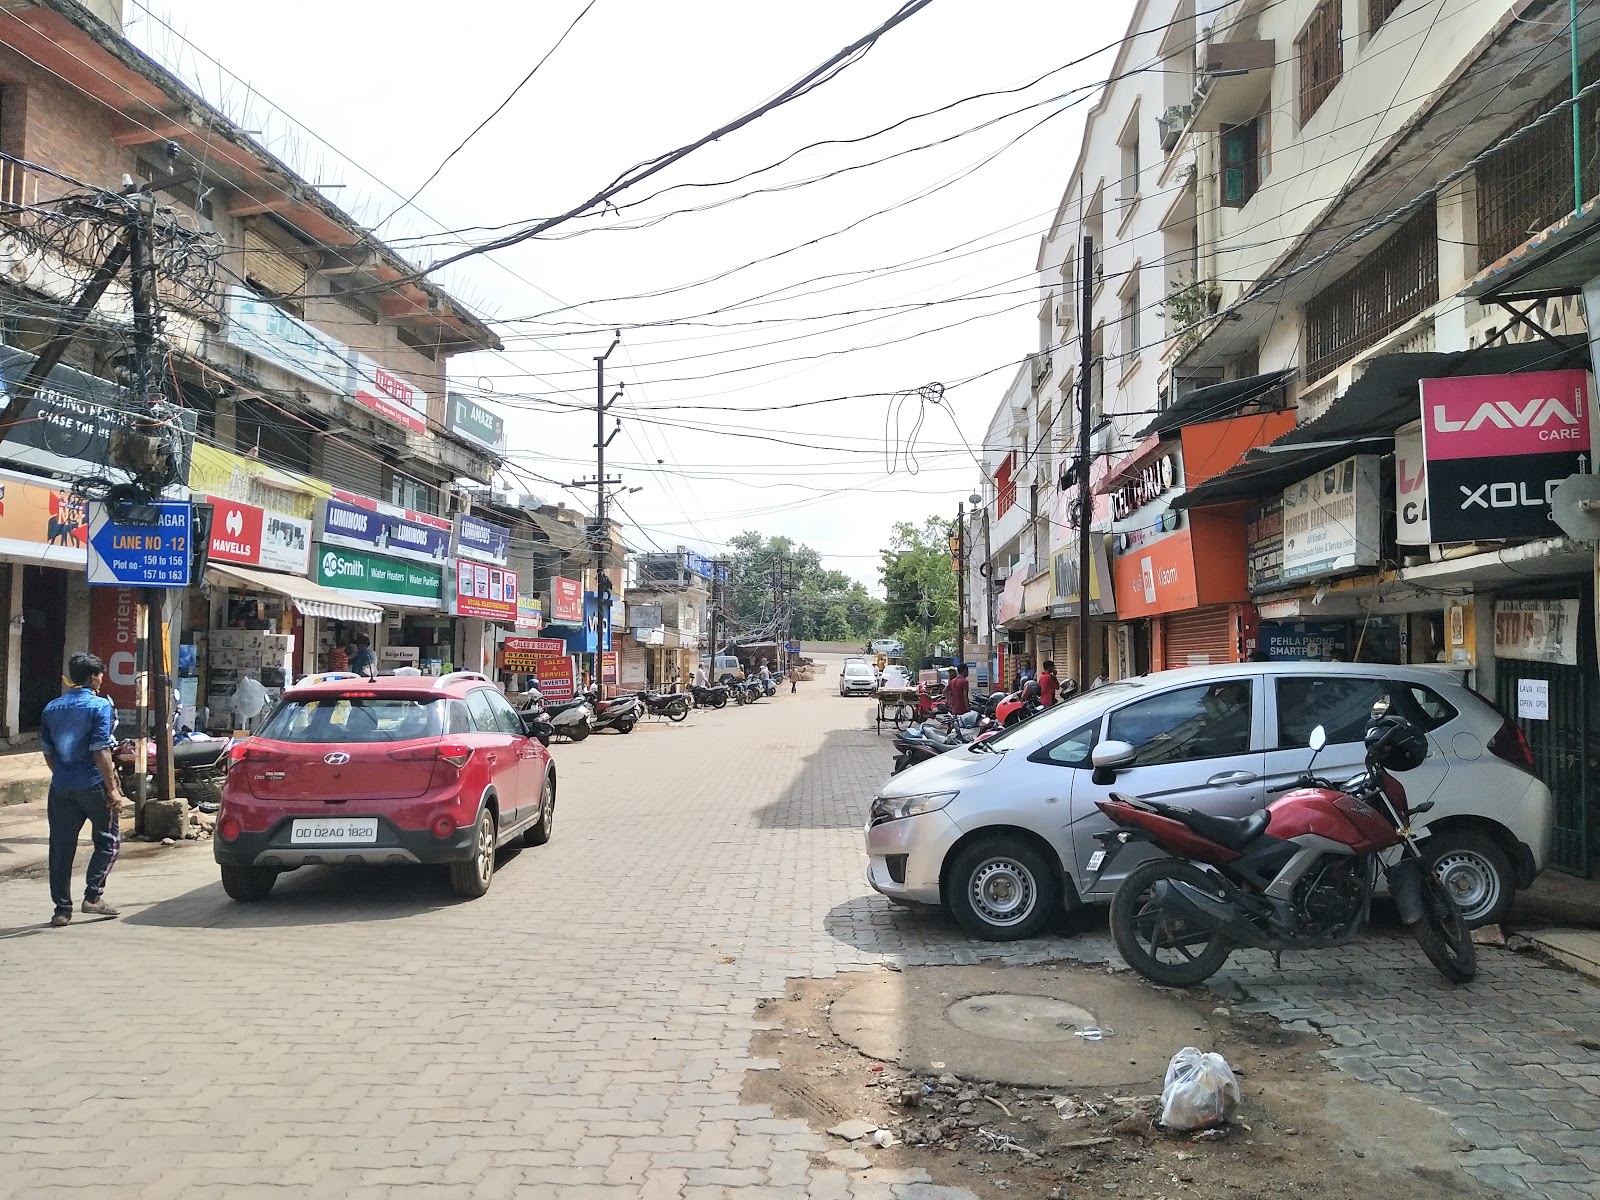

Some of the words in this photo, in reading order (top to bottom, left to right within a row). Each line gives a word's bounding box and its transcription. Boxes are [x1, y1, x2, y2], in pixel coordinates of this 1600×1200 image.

[38, 410, 73, 428] CHASE
[75, 420, 94, 435] THE
[470, 406, 494, 430] AMAZE
[1433, 397, 1579, 433] LAVA
[1538, 428, 1581, 441] CARE
[154, 514, 185, 527] AGAR
[329, 507, 368, 533] LUMINOUS
[1310, 495, 1355, 530] ELECTRONICS
[397, 524, 428, 546] LUMINOUS
[461, 520, 491, 545] LUMINOUS
[1313, 533, 1323, 542] Kinds
[113, 535, 142, 550] LANE
[145, 536, 161, 551] NO
[212, 538, 251, 556] HAVELLS
[1314, 545, 1324, 555] Sales
[1329, 541, 1342, 551] Service
[1343, 538, 1353, 547] Here
[113, 559, 127, 570] Plot
[143, 555, 157, 565] 150
[159, 555, 166, 565] to
[168, 556, 183, 566] 156
[143, 569, 157, 579] 157
[159, 570, 166, 579] to
[168, 570, 183, 580] 163
[370, 566, 386, 579] Water
[386, 569, 404, 582] Heaters
[409, 574, 422, 585] Water
[422, 576, 439, 587] Purifiers
[114, 585, 131, 643] orient
[589, 611, 608, 633] vio
[1496, 612, 1520, 645] STD
[513, 641, 530, 649] SALES
[537, 642, 560, 650] SERVICE
[1270, 637, 1302, 646] PEHLA
[1519, 684, 1533, 693] LAVA
[1519, 699, 1533, 708] OPEN
[295, 828, 311, 838] OD
[347, 827, 373, 838] 1820
